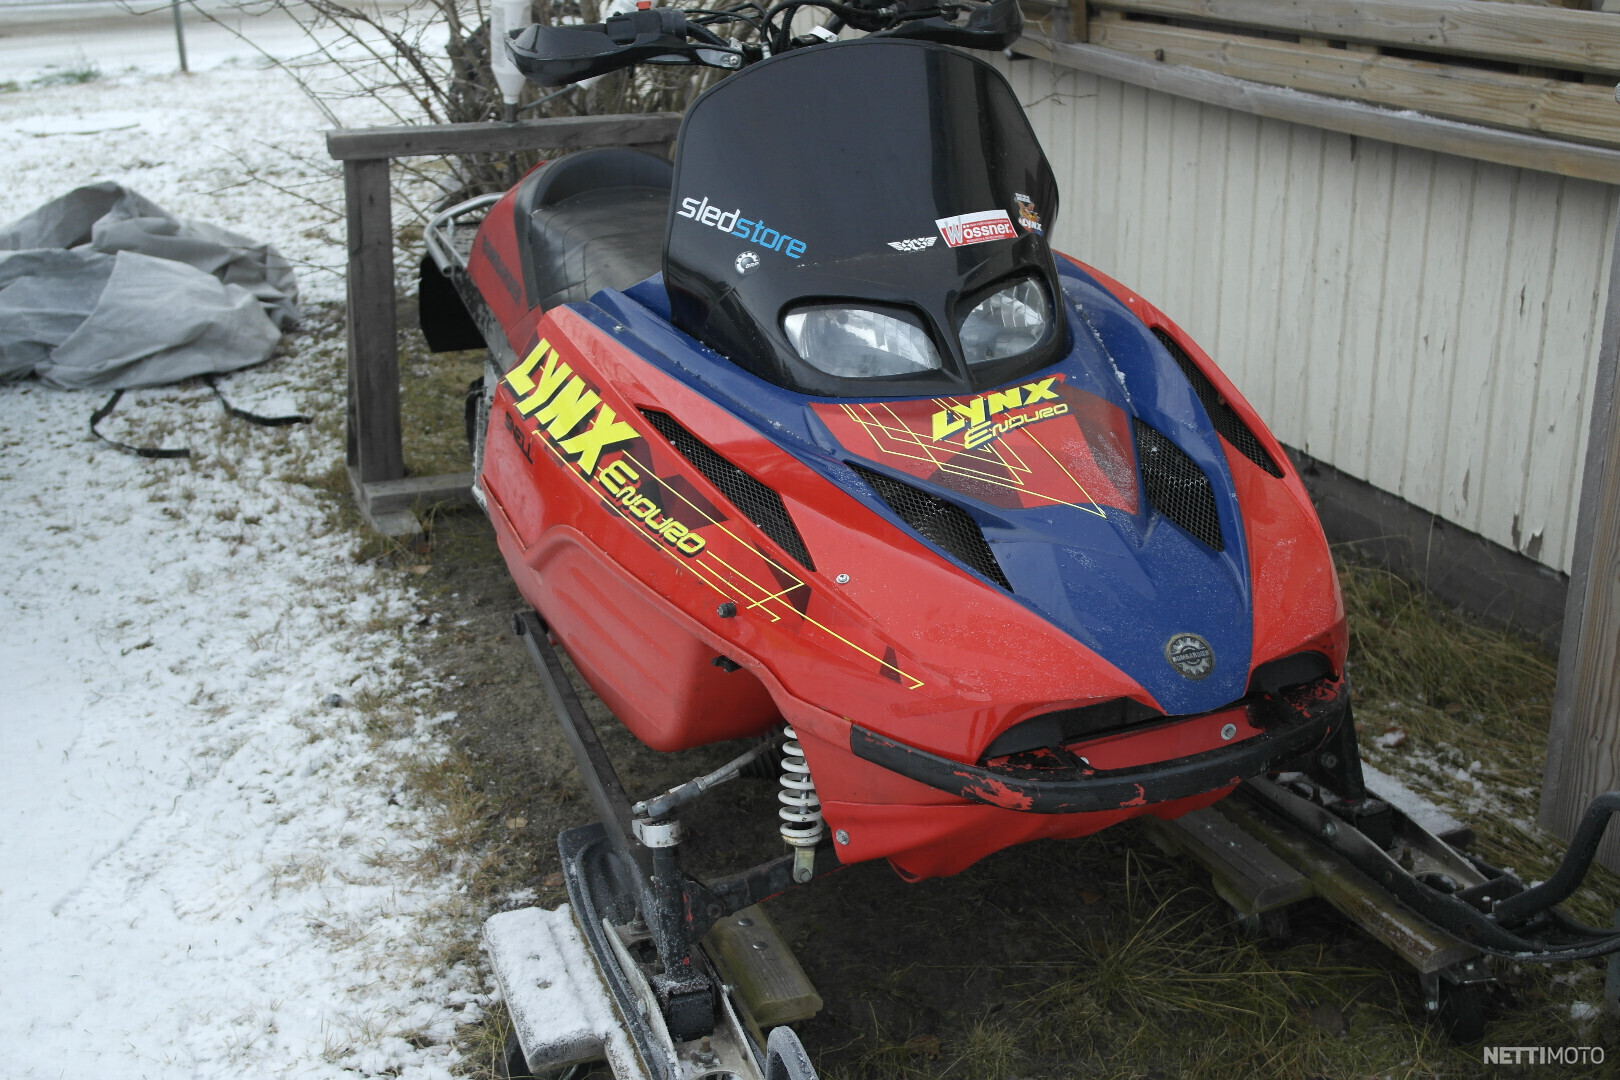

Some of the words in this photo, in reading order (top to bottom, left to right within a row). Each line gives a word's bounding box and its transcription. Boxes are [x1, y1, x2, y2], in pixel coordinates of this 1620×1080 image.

[677, 196, 807, 259] sledstore
[944, 216, 1011, 245] Wössner
[504, 337, 642, 476] LYNX
[932, 377, 1060, 443] LYNX
